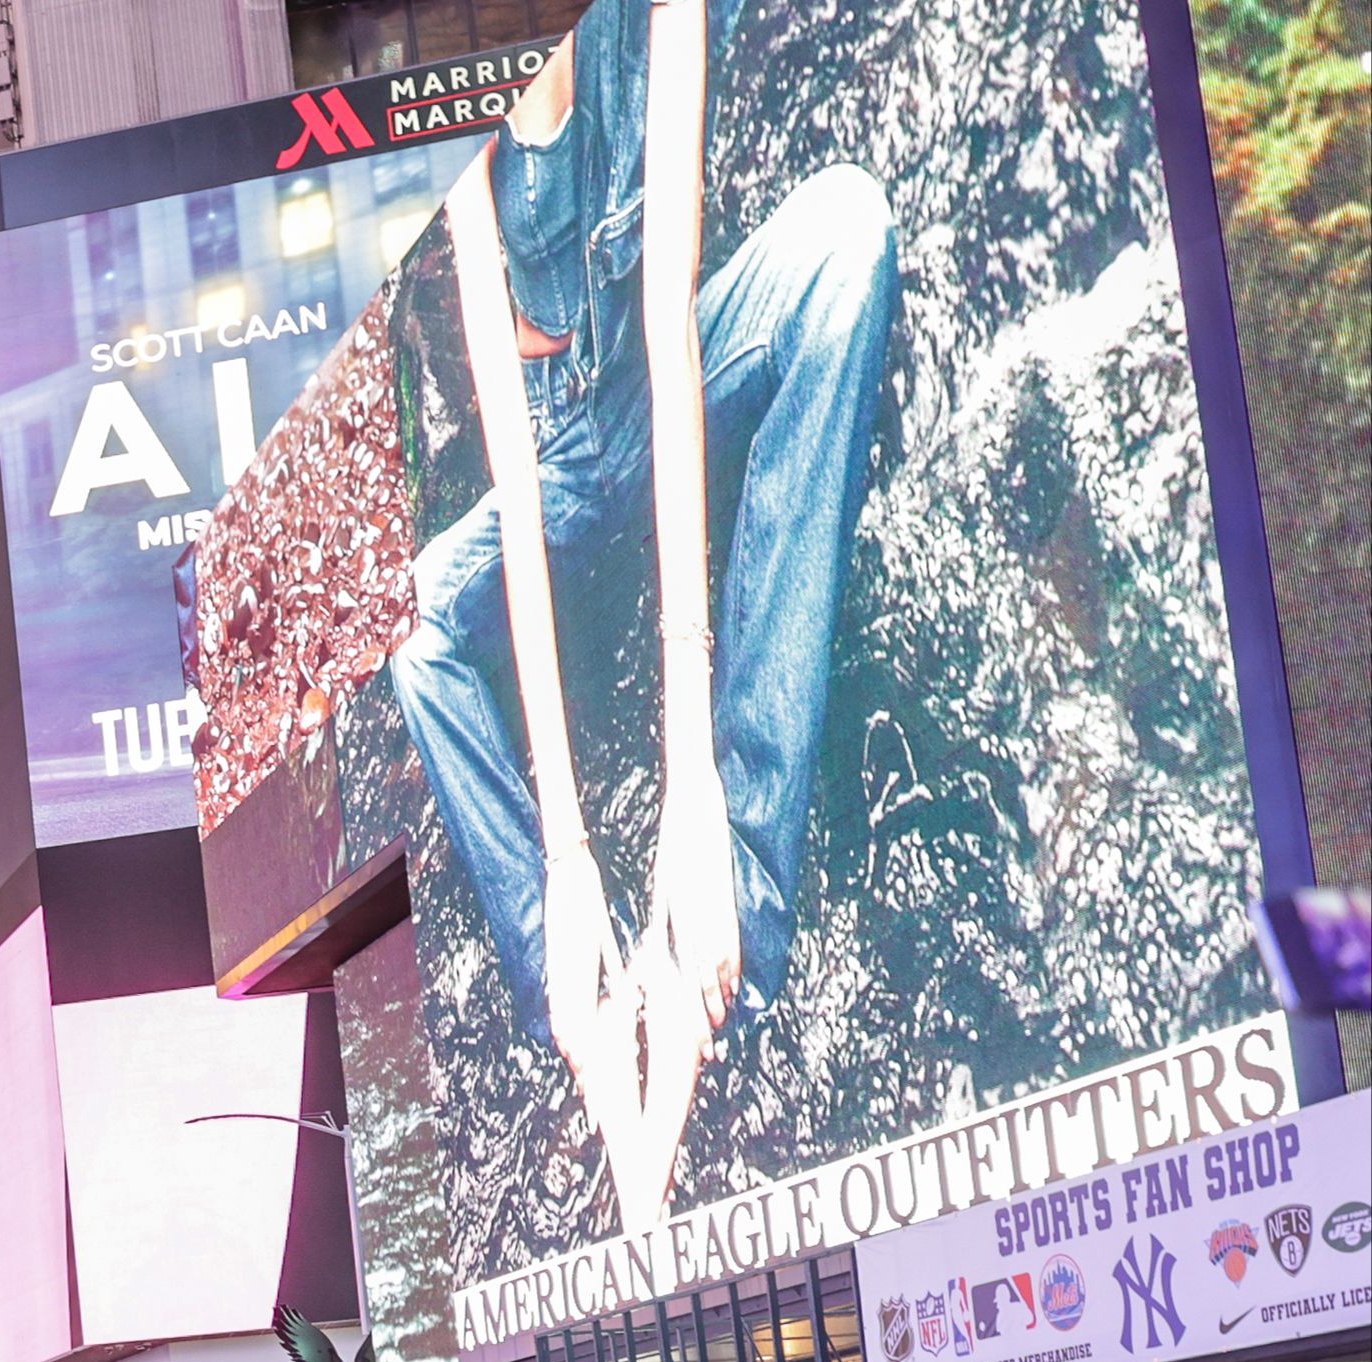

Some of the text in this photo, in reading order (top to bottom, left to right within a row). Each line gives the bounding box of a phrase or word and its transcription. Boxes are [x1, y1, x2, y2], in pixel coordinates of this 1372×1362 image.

[90, 302, 326, 373] SCOTT CAAN
[458, 1027, 1289, 1354] AMERICAN EAGLE OUTFITTERS
[994, 1122, 1301, 1259] SPORTS FAN SHOP
[1268, 1207, 1310, 1242] NETS
[1328, 1217, 1371, 1241] JETS
[1286, 1240, 1296, 1266] B
[1261, 1293, 1337, 1324] OFFICIALLY
[885, 1313, 907, 1353] NHL
[921, 1318, 947, 1349] NFL
